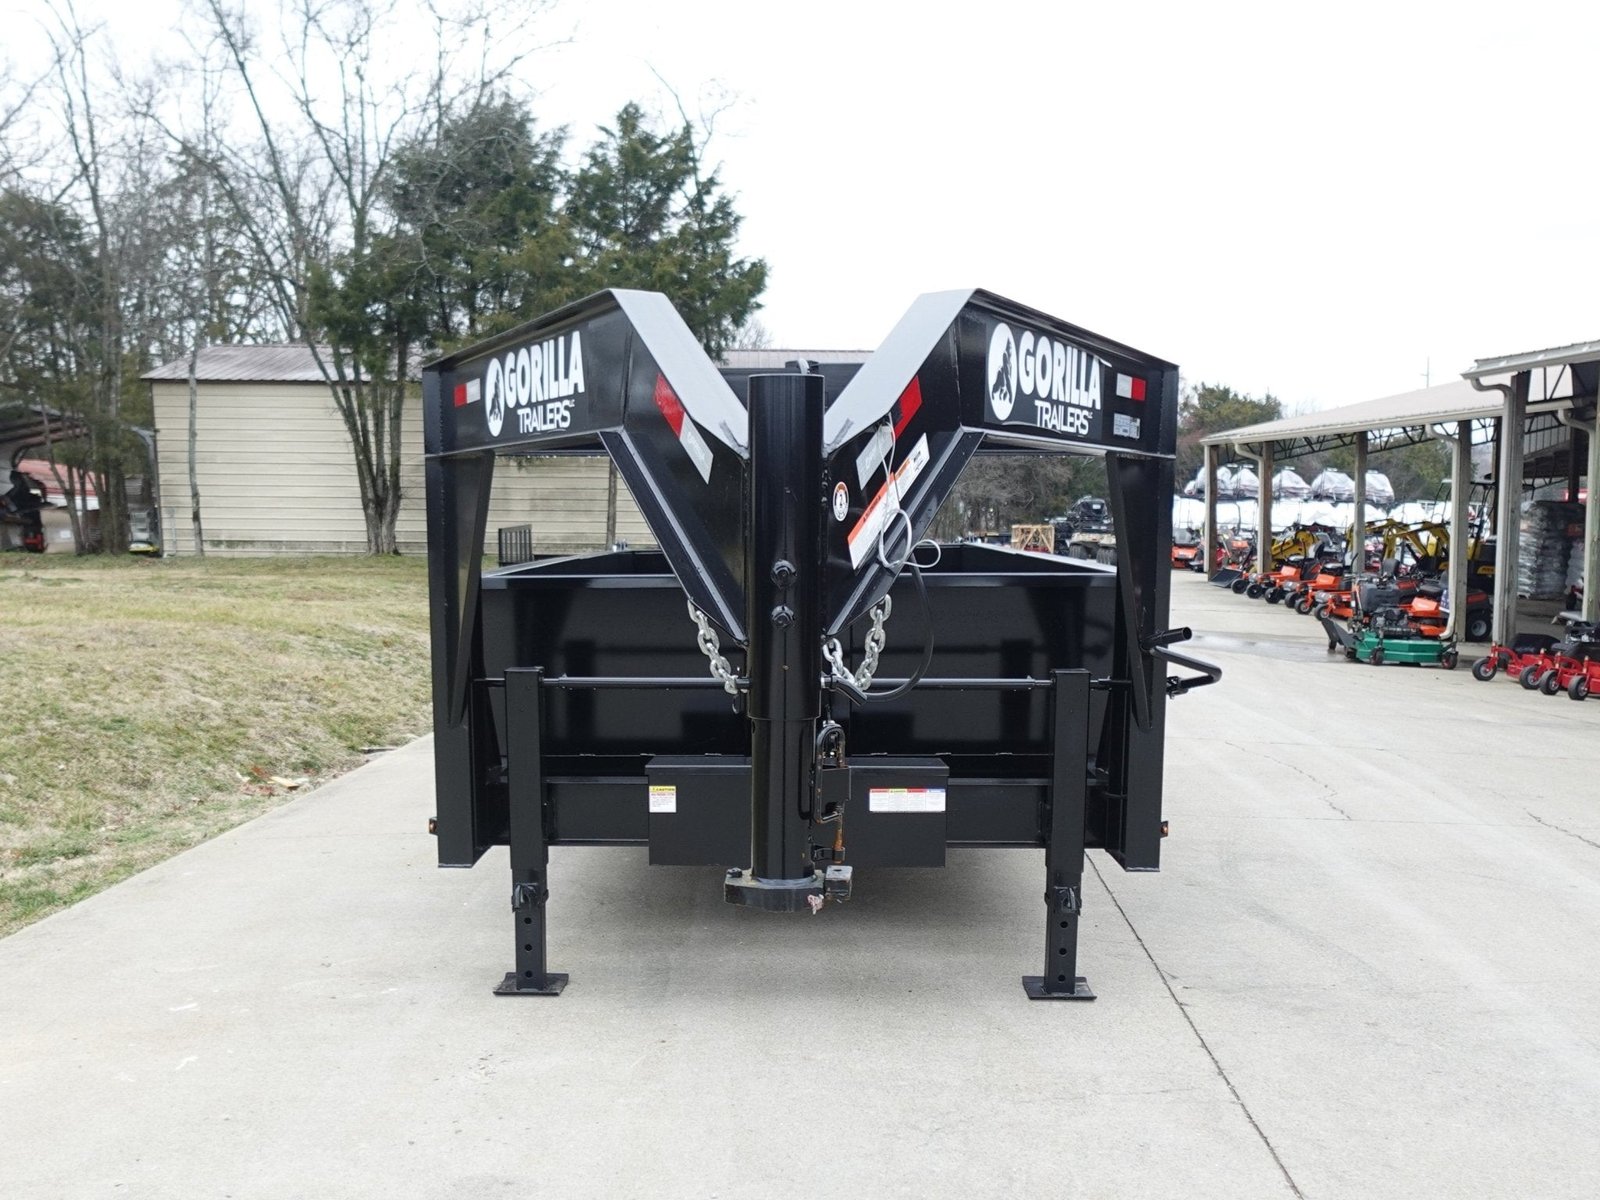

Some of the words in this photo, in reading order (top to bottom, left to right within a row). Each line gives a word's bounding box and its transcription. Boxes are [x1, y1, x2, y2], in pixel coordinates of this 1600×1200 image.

[504, 330, 585, 409] GORILLA
[1019, 330, 1101, 410] GORILLA
[517, 399, 571, 434] TRAILERS
[1034, 399, 1089, 435] TRAILERS
